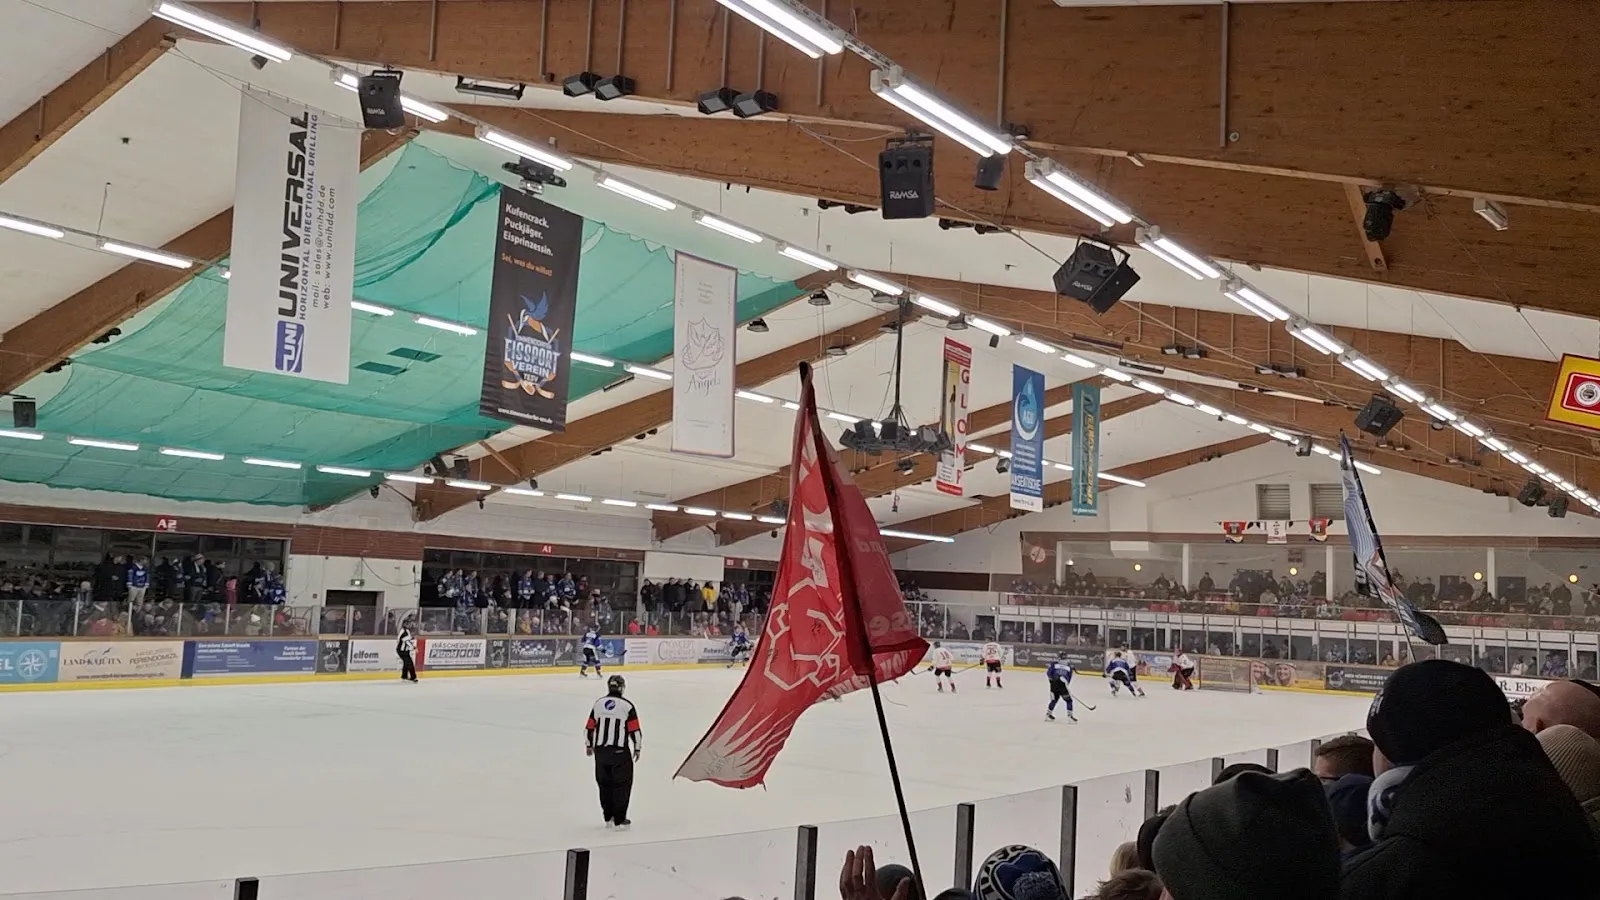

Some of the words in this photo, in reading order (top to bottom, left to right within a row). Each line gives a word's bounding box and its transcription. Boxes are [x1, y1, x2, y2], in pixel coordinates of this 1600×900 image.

[307, 113, 318, 166] DRILLING
[303, 170, 315, 245] DIRECTIONAL
[890, 190, 919, 199] RAMSA
[278, 110, 309, 318] UNIVERSAL
[504, 216, 544, 240] Puckjäger.
[505, 203, 549, 229] Kufencrack.
[314, 184, 326, 275] sales@unihdd.de
[323, 187, 336, 279] www.unihdd.com
[503, 231, 553, 256] Eisprinzessin.
[299, 248, 310, 320] HORIZONTAL
[312, 280, 320, 308] mail:
[321, 283, 331, 309] web:
[284, 322, 299, 360] UNI
[504, 337, 561, 374] EISSPORT
[511, 361, 550, 379] VEREIN
[157, 518, 177, 529] A2
[1516, 682, 1539, 693] Ebe
